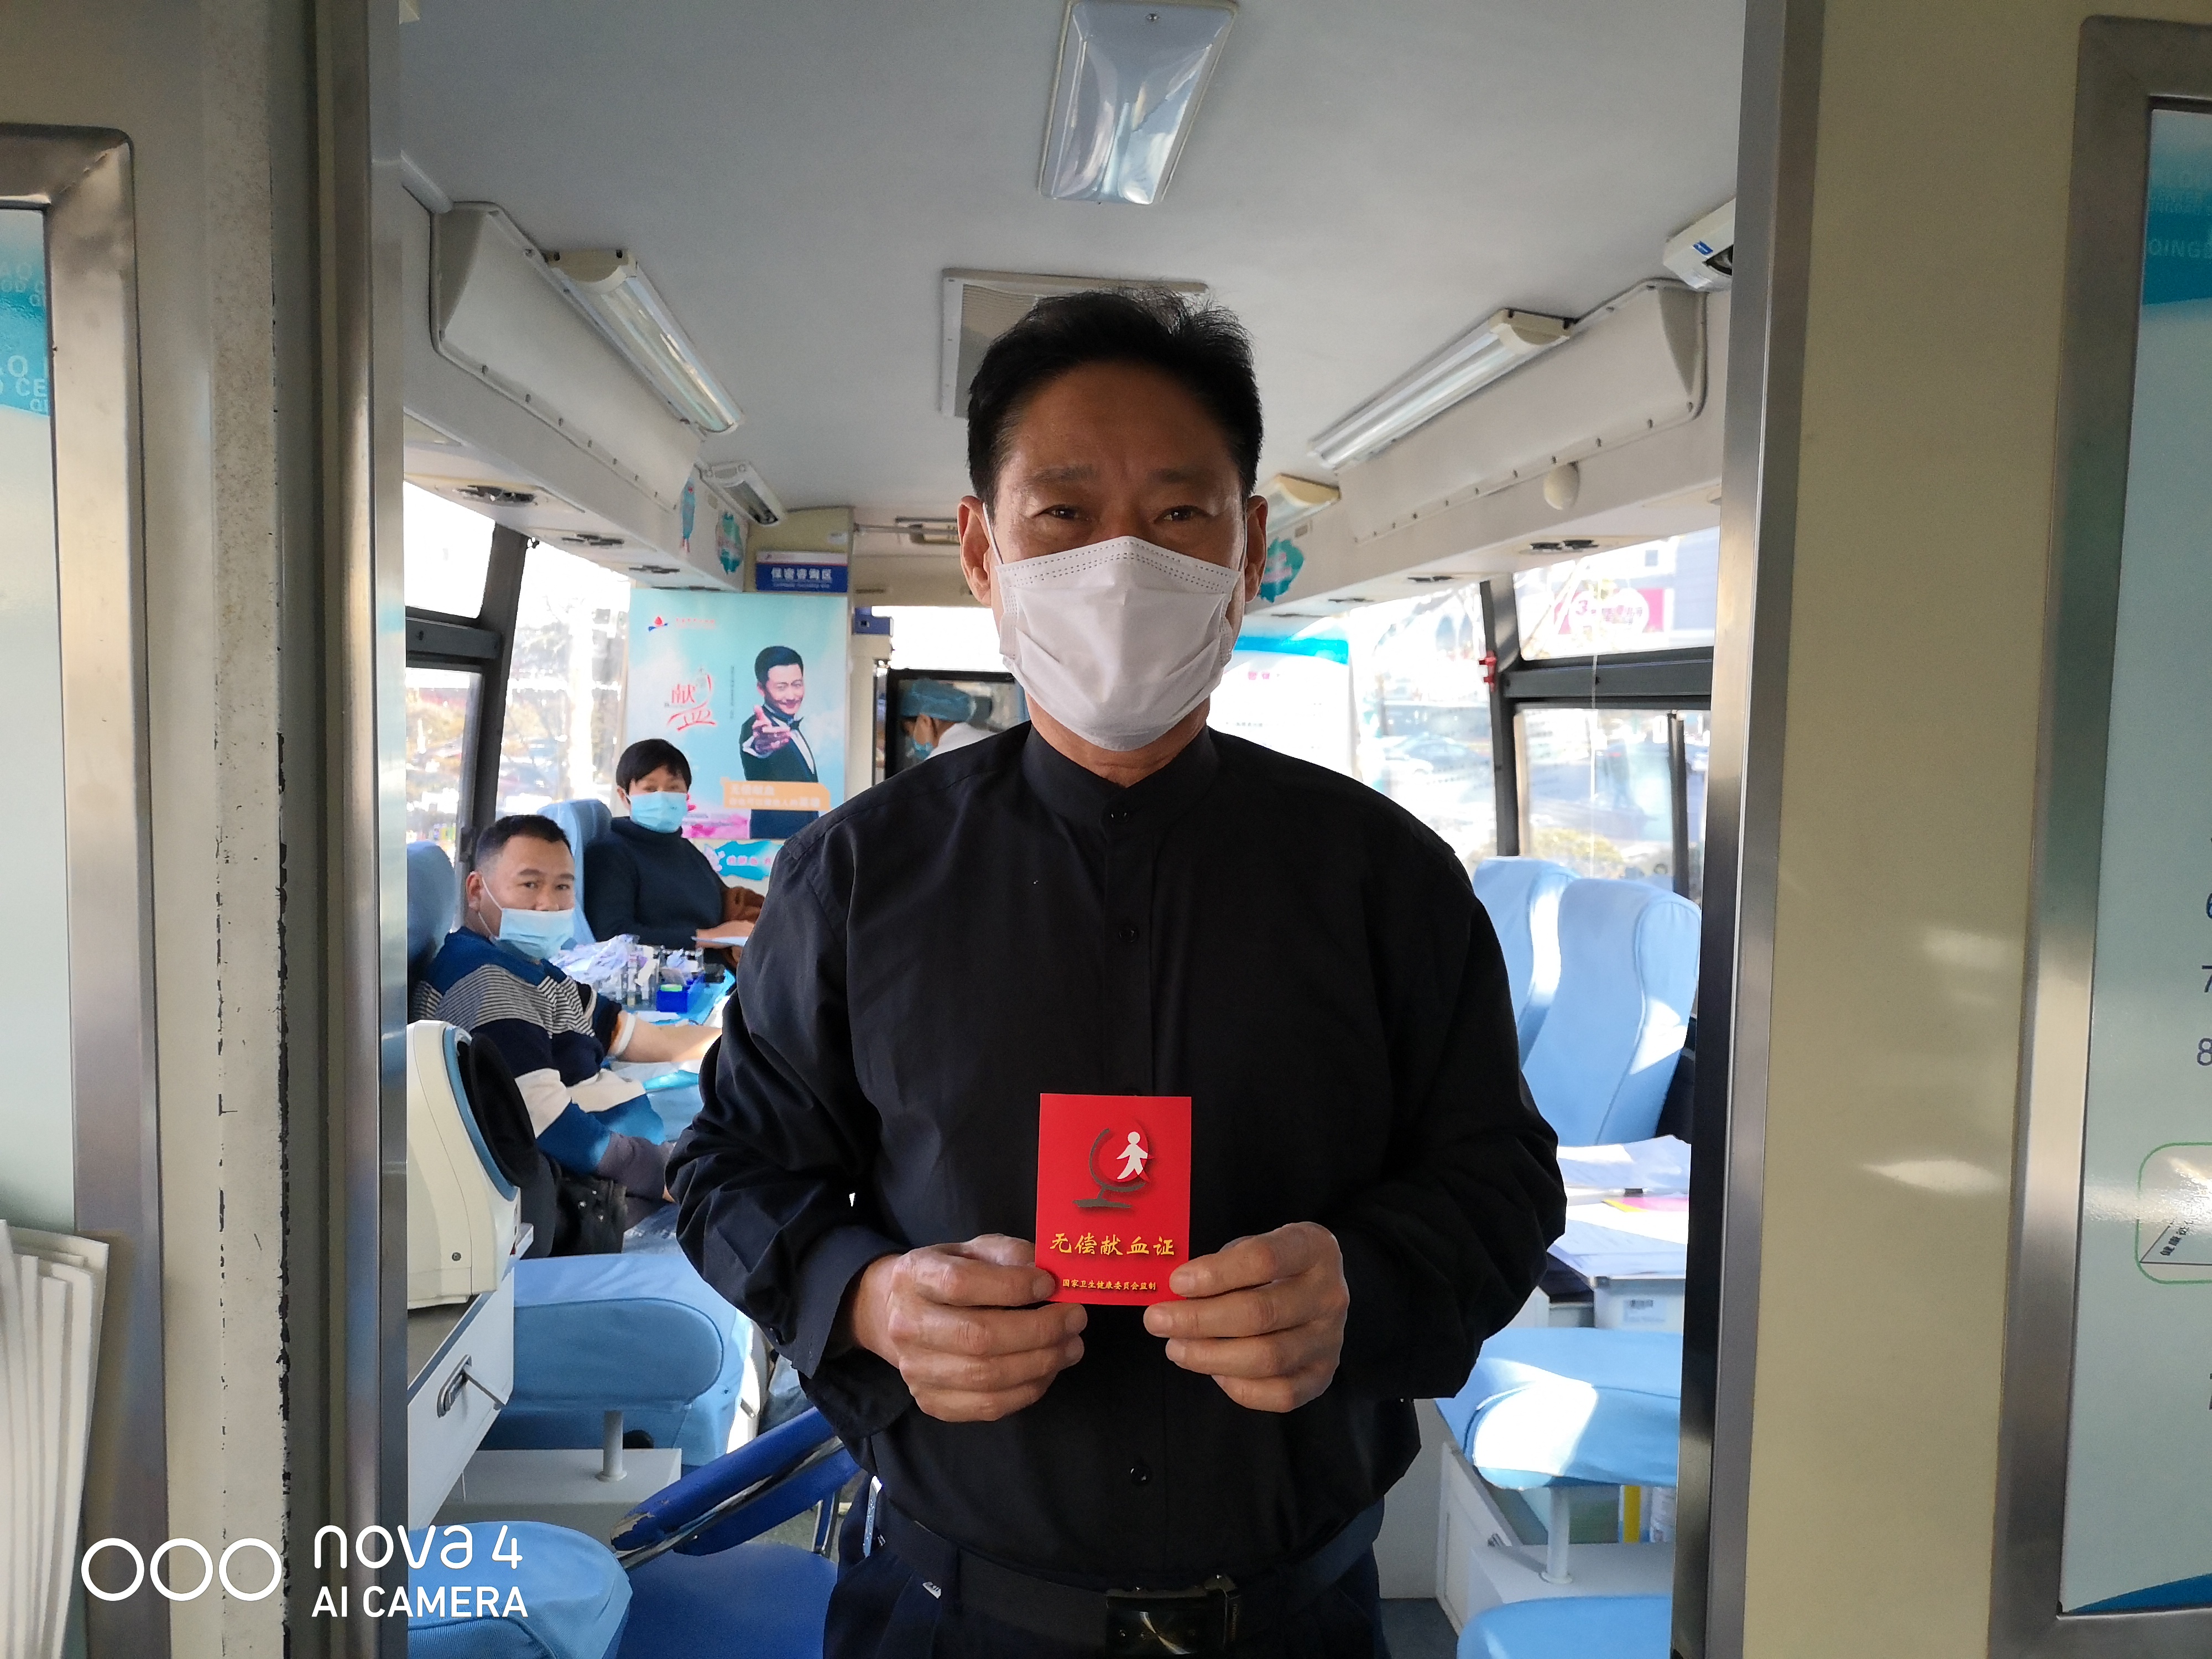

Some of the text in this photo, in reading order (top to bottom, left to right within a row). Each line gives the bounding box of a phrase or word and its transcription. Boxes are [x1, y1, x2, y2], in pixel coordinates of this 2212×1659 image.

[1049, 1232, 1175, 1256] 无偿献血证
[1062, 1279, 1156, 1291] 国家卫生健康委员会监制
